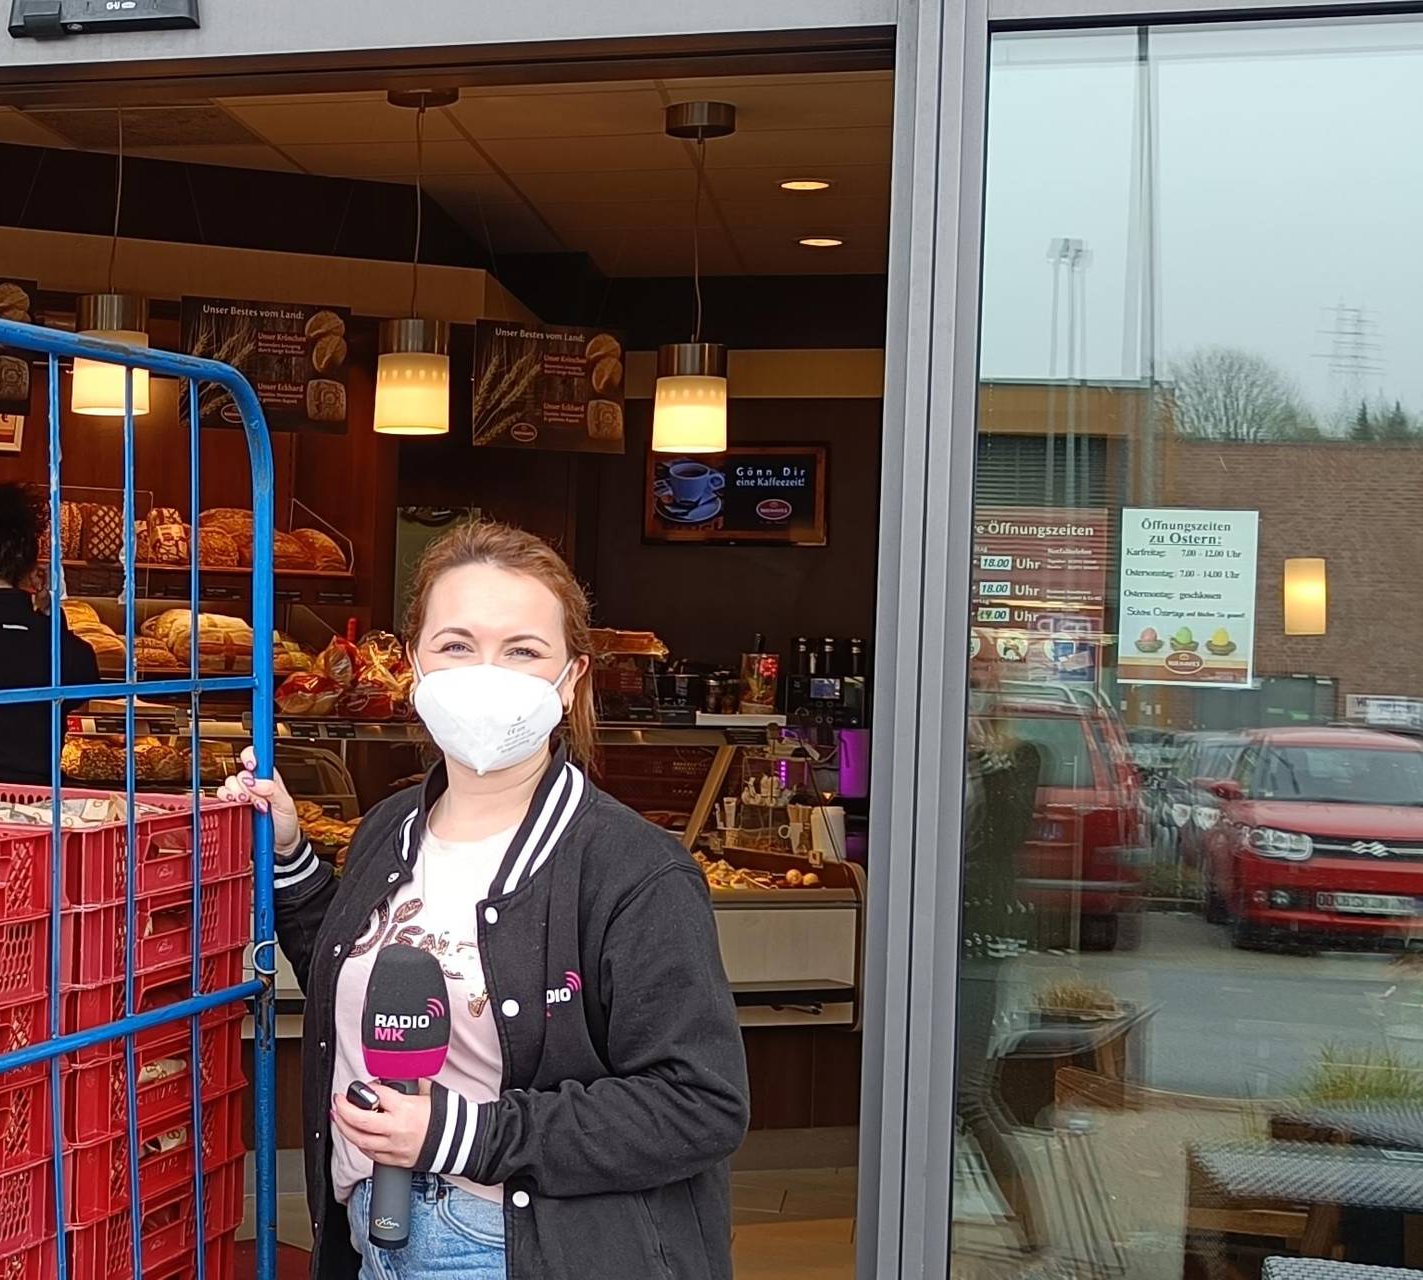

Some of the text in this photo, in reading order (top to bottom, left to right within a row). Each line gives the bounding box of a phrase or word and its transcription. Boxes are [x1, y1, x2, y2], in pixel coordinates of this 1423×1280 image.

[203, 304, 305, 320] Unser Bestes vom Land:
[495, 327, 585, 343] Unser Bestes vom Land:
[736, 467, 806, 476] Gönn Dir
[736, 477, 805, 487] eine Kaffeezeit!
[988, 520, 1094, 538] Öffnungszeiten
[1141, 518, 1231, 532] Öffnungszeiten
[1149, 533, 1222, 545] zu Ostern:
[1205, 549, 1224, 557] 12.00
[1227, 550, 1242, 558] Uhr
[982, 558, 1010, 568] 18.00
[1016, 558, 1041, 569] Uhr
[1225, 571, 1240, 579] Uhr
[981, 583, 1009, 593] 18.00
[1015, 585, 1040, 596] Uhr
[1014, 610, 1039, 621] Uhr
[375, 1013, 430, 1030] RADIO
[374, 1027, 405, 1042] MK
